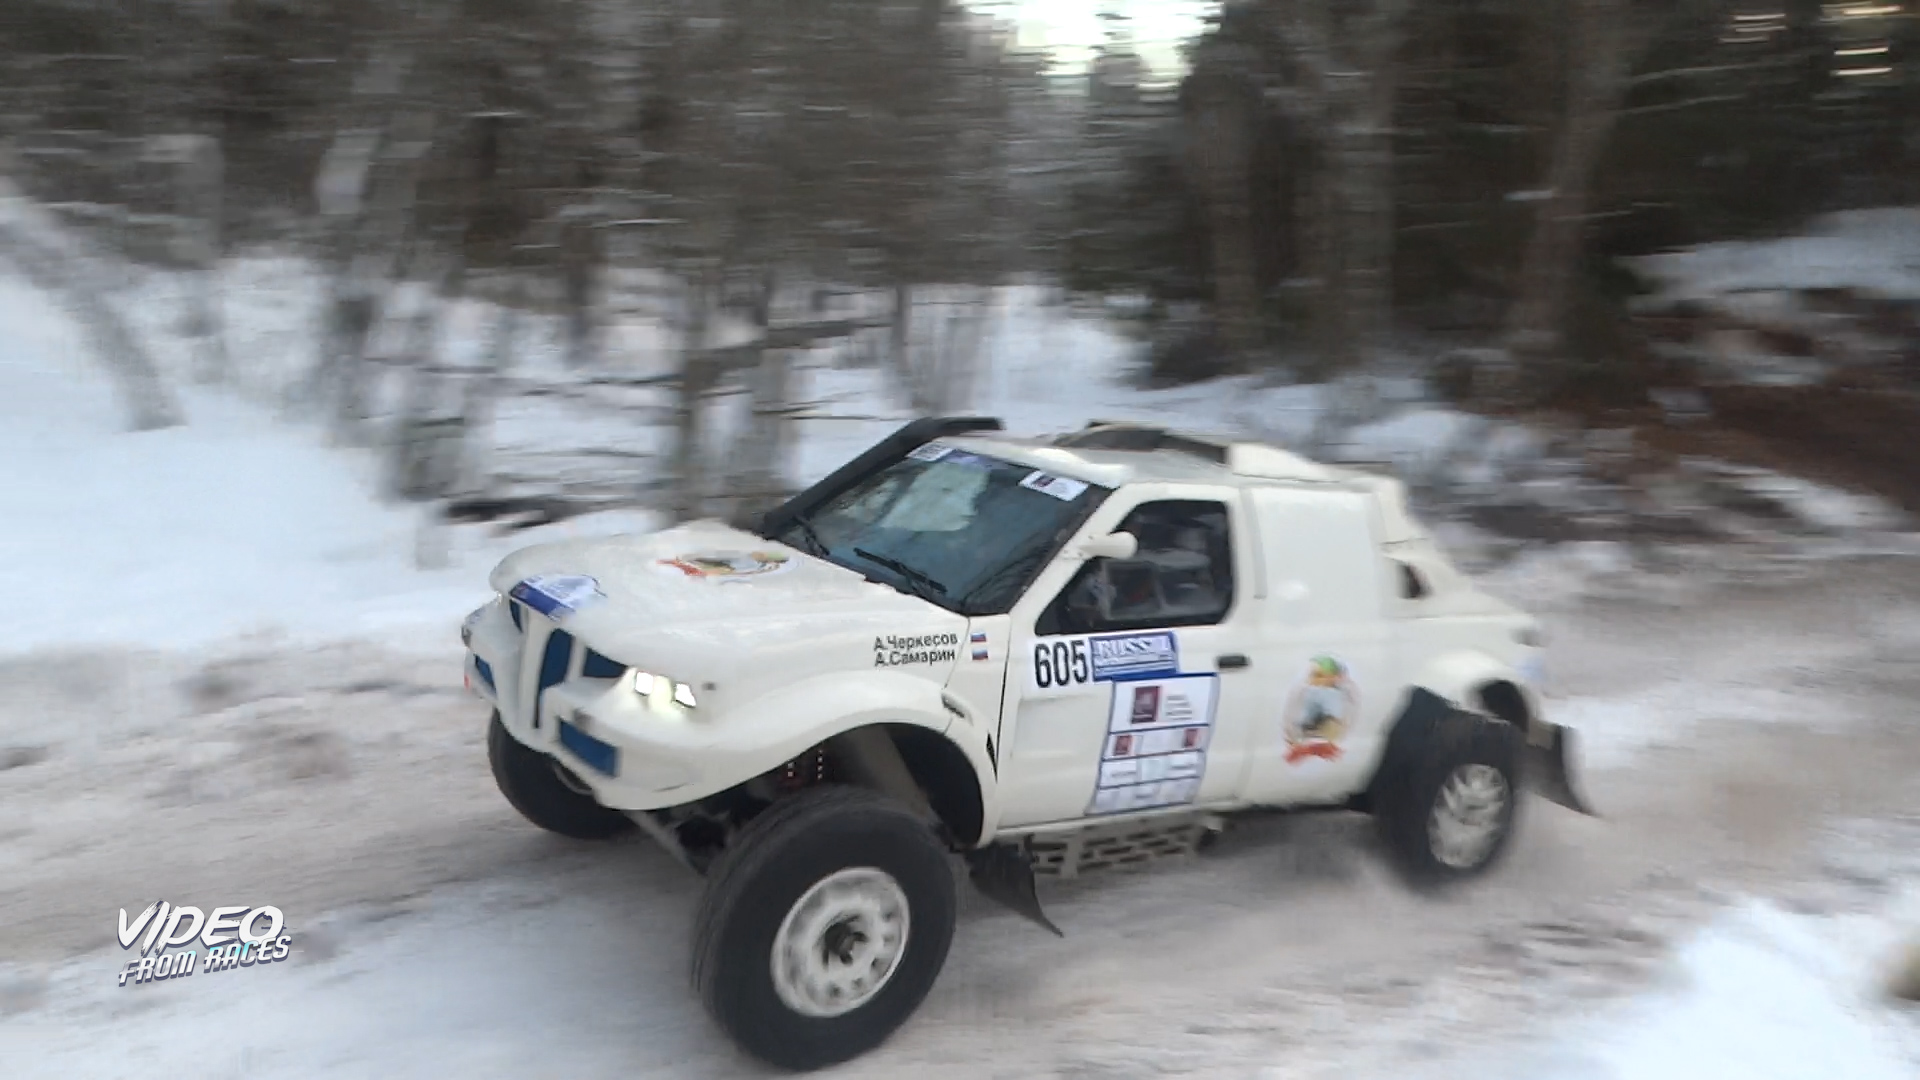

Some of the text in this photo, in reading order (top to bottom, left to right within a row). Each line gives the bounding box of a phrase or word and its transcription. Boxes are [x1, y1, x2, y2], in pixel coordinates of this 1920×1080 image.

[873, 633, 958, 651] А.Черкесов
[874, 649, 955, 666] А.Самарин
[1034, 640, 1088, 688] 605
